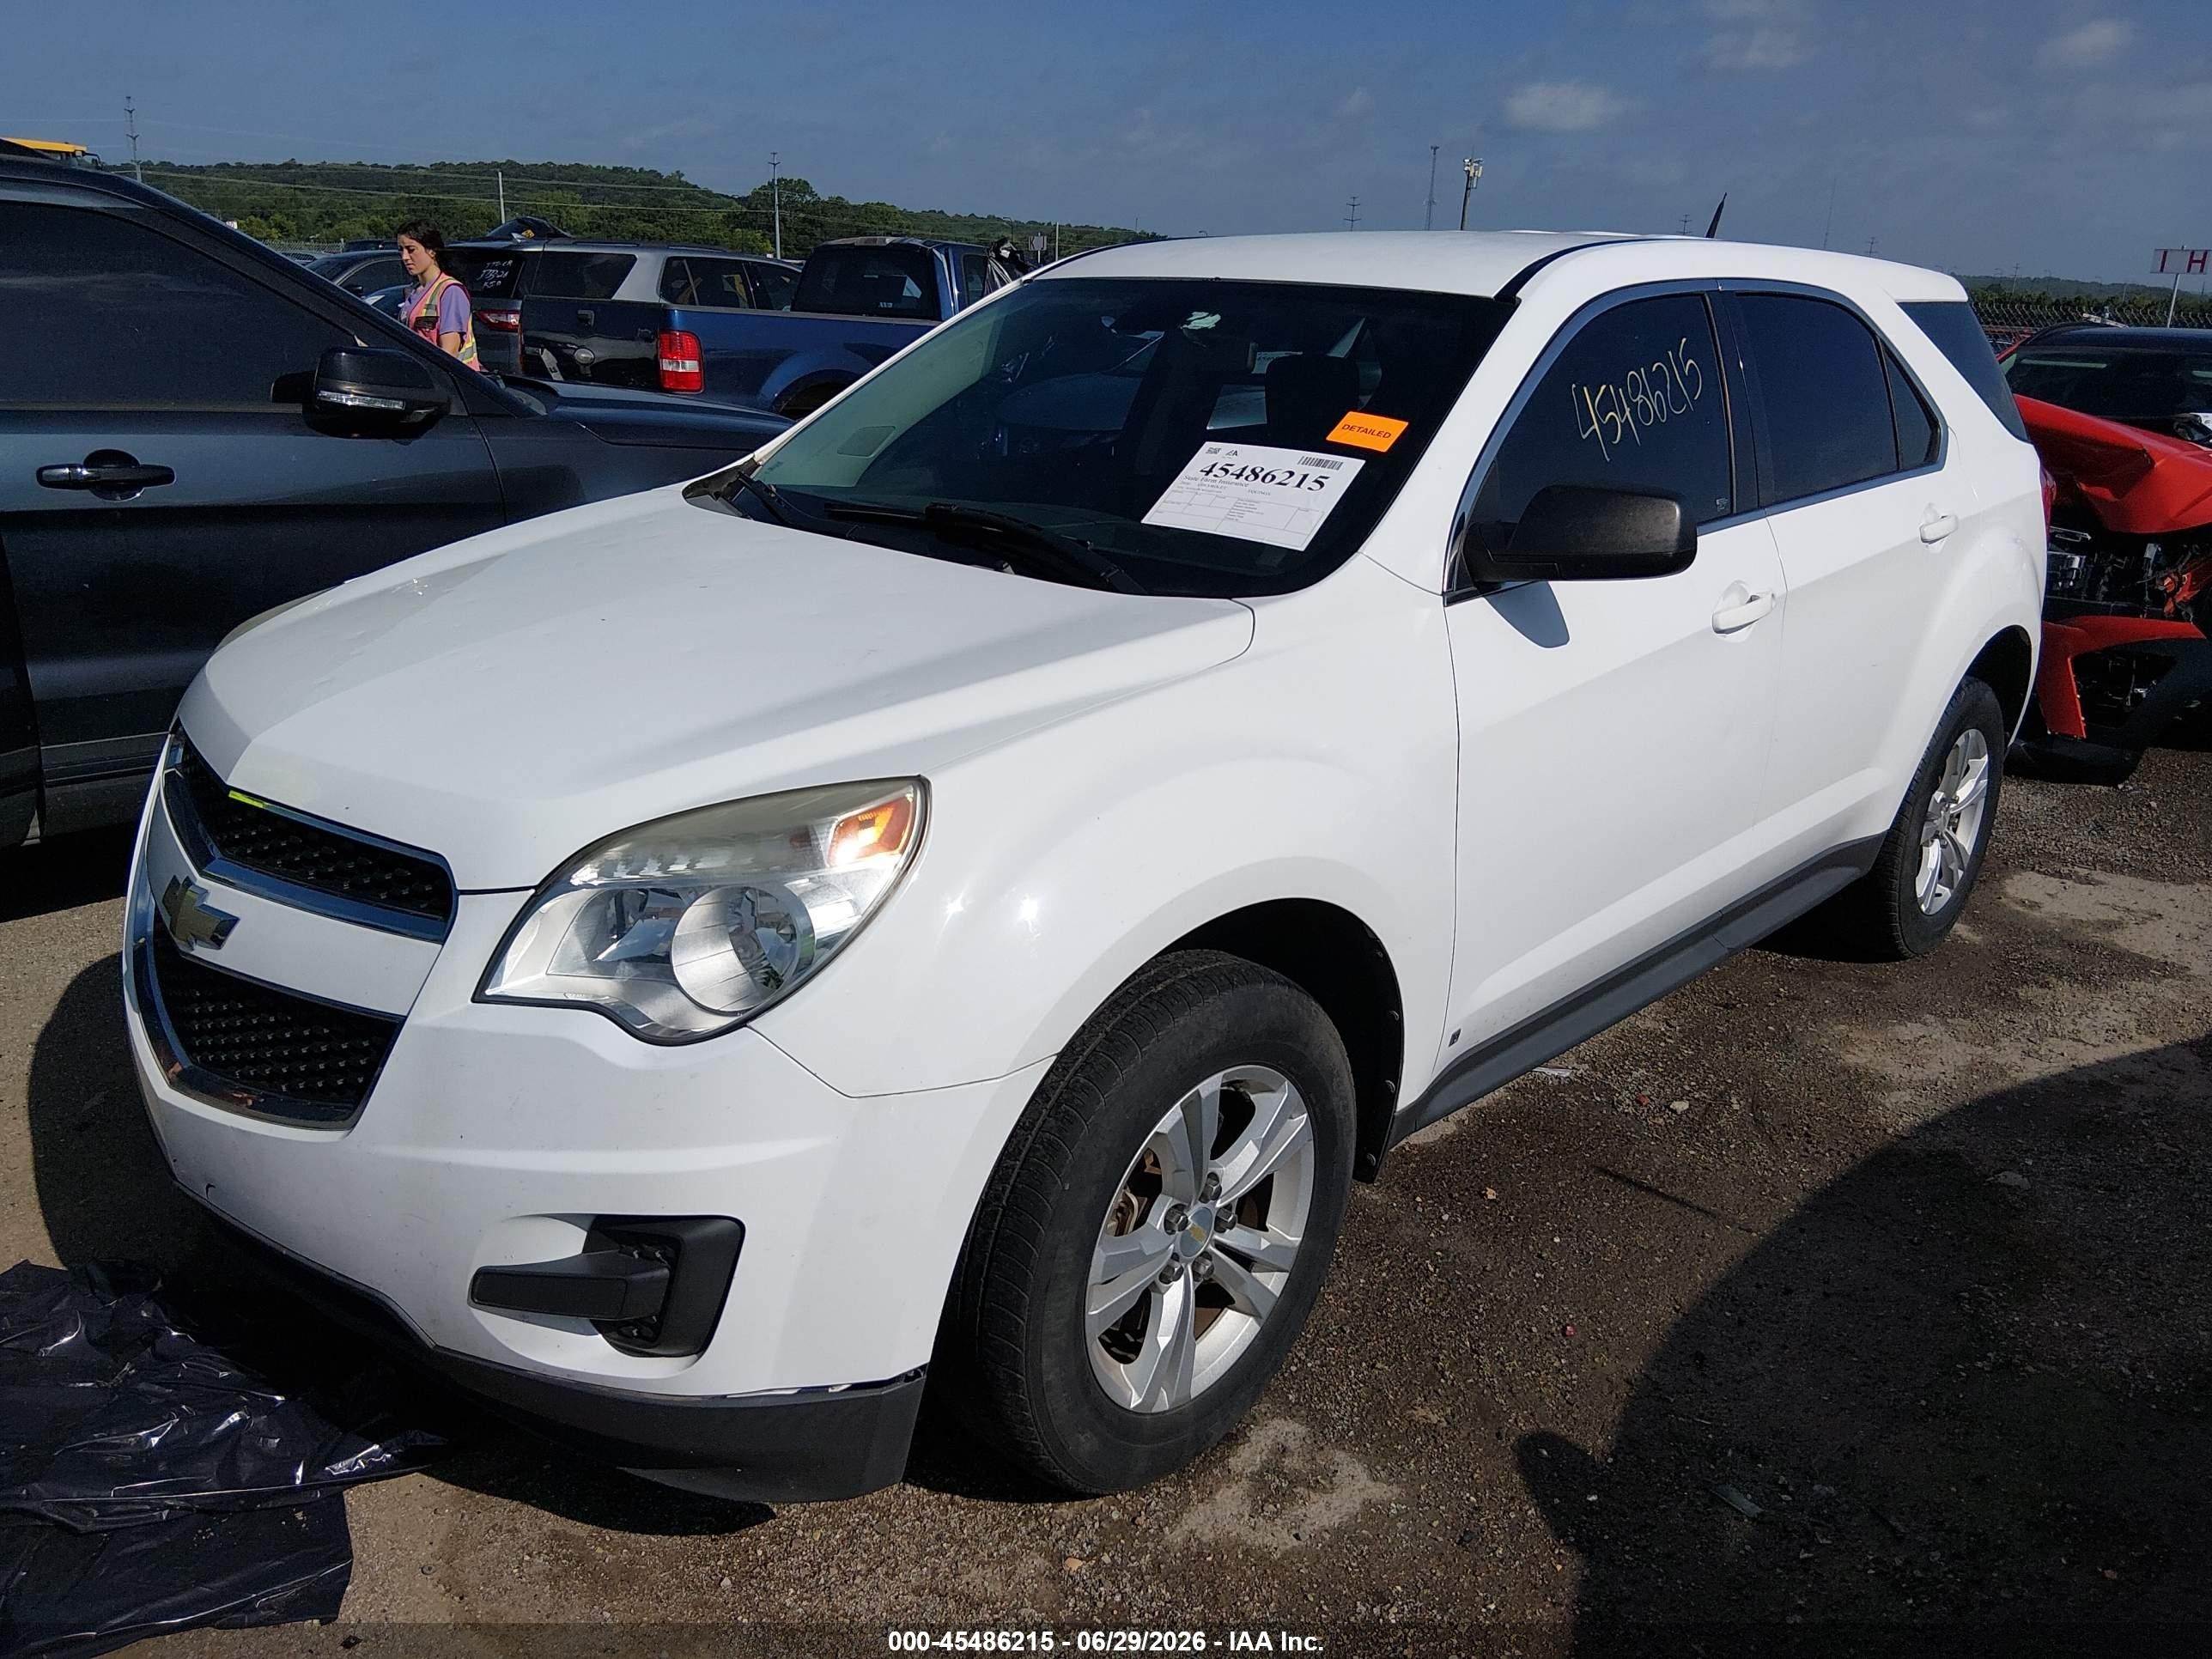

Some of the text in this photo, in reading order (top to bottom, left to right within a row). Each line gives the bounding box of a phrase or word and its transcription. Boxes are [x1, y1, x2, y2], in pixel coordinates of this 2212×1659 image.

[2186, 250, 2209, 273] H
[1571, 337, 1703, 462] 45486215
[1340, 422, 1393, 441] DETAILED
[1199, 461, 1331, 493] 45486215
